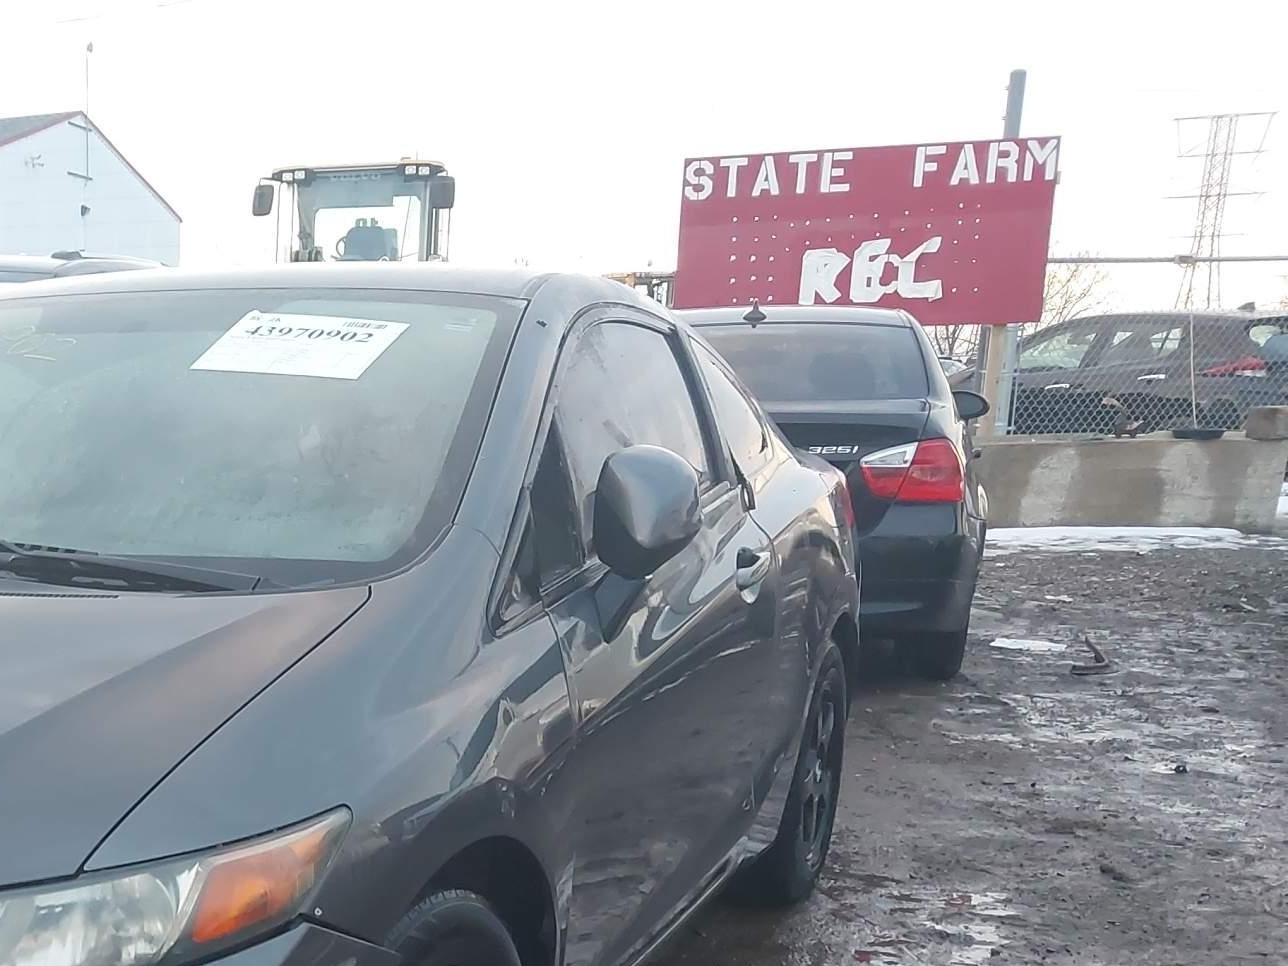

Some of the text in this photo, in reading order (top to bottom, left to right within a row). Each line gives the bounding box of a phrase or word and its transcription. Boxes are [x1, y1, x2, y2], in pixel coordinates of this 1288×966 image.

[684, 138, 1060, 201] STATE FARM
[244, 324, 374, 343] 43970902
